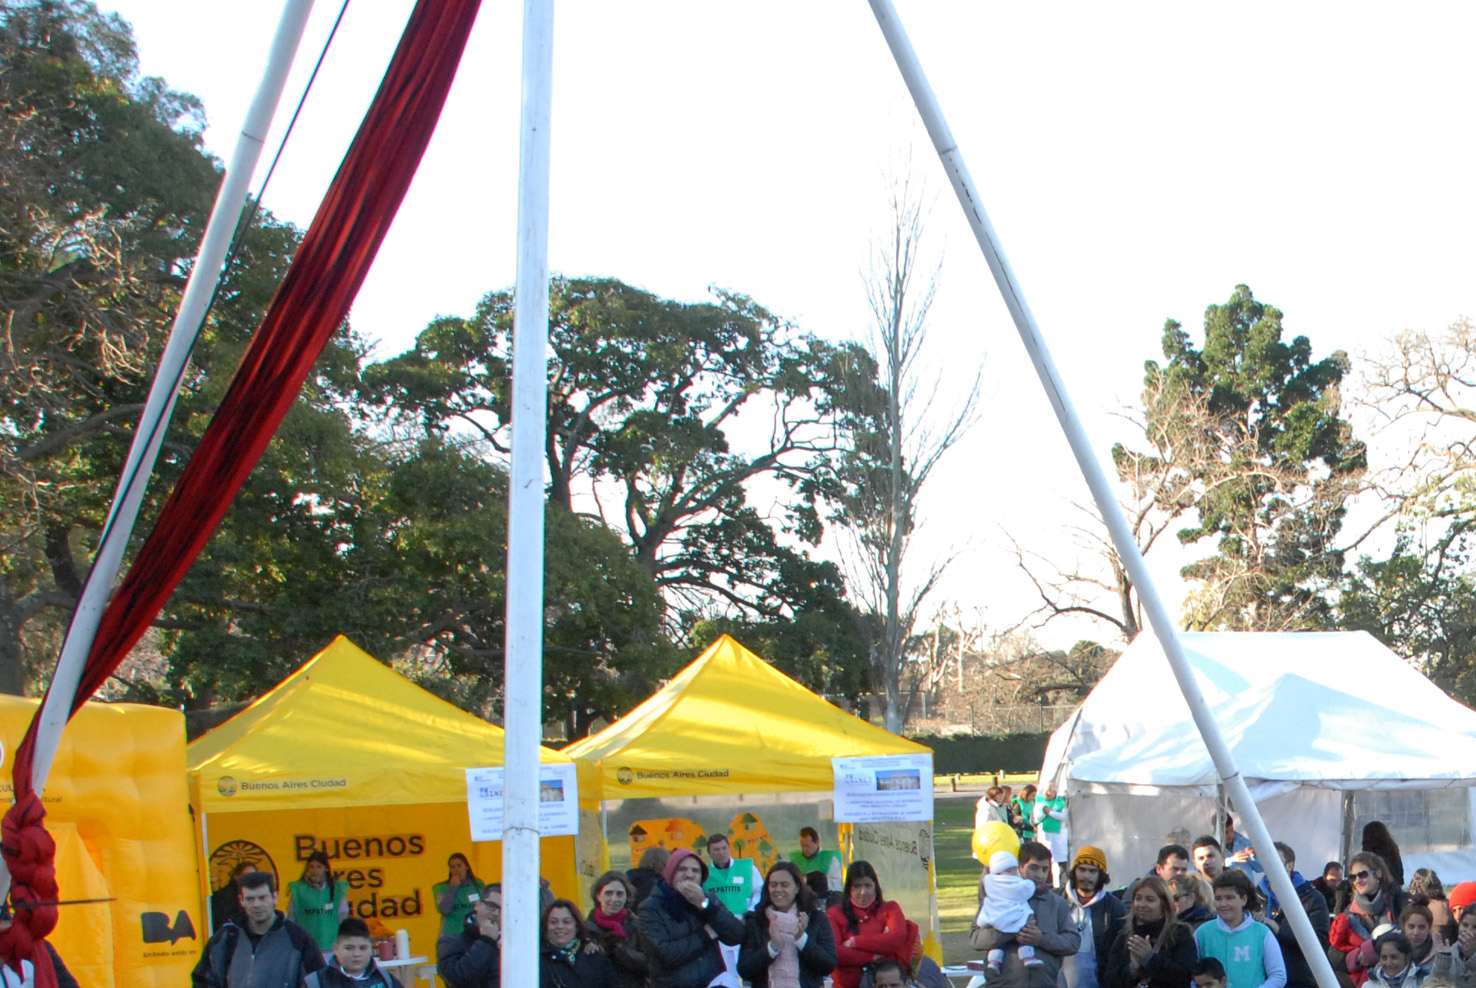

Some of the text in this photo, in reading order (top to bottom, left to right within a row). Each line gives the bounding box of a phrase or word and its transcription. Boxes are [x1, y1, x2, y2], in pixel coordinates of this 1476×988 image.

[637, 769, 729, 780] Buenos Aires Ciudad
[241, 778, 347, 791] Buenos Aires Ciudad
[294, 833, 425, 862] Buenos
[333, 868, 384, 889] res
[1233, 945, 1250, 962] M
